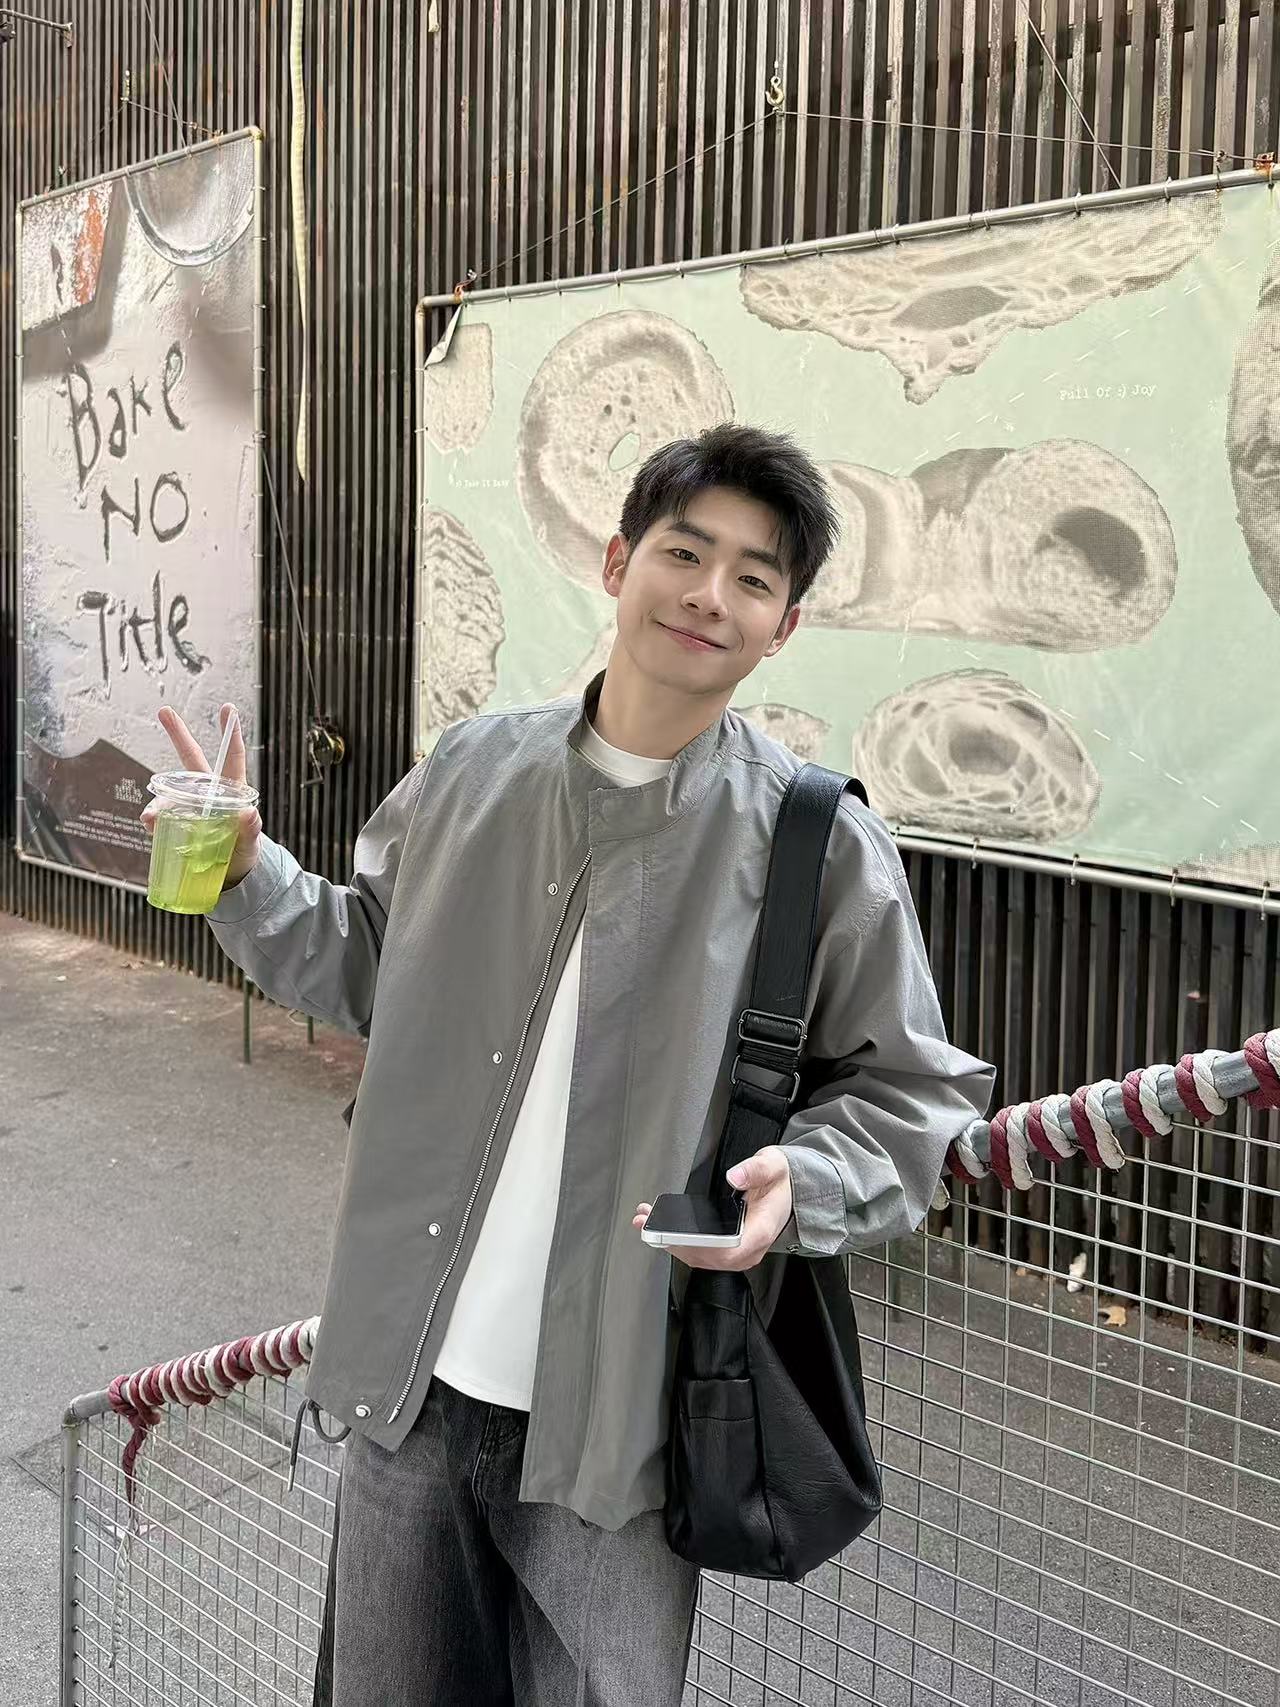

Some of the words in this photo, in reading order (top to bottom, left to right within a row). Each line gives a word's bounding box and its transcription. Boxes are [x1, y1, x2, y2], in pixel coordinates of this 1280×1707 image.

[62, 340, 186, 497] Bake
[1131, 384, 1157, 397] Joy
[77, 569, 212, 698] Title
